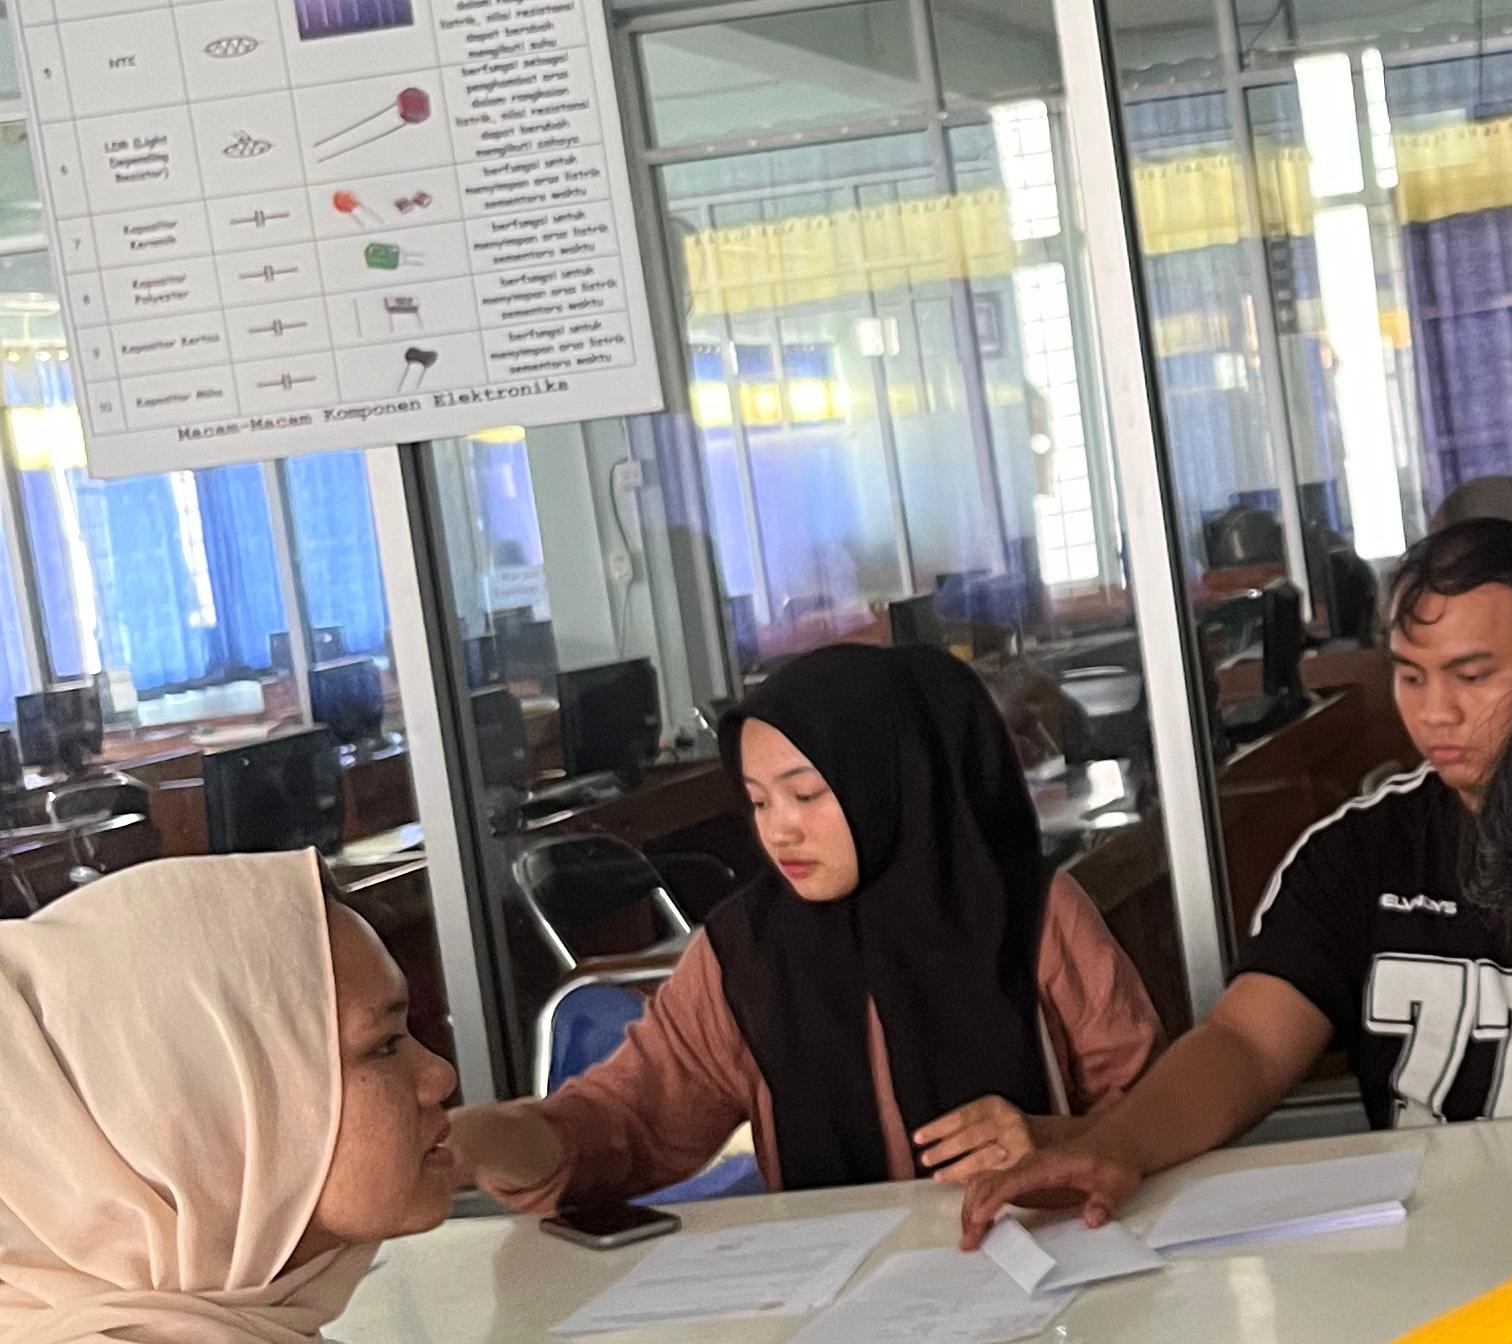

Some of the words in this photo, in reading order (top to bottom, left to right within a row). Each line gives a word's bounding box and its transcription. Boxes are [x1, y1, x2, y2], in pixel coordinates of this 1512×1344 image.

[177, 414, 311, 441] Macam-Macam
[323, 400, 420, 421] Komponen
[428, 377, 568, 407] Elektronika
